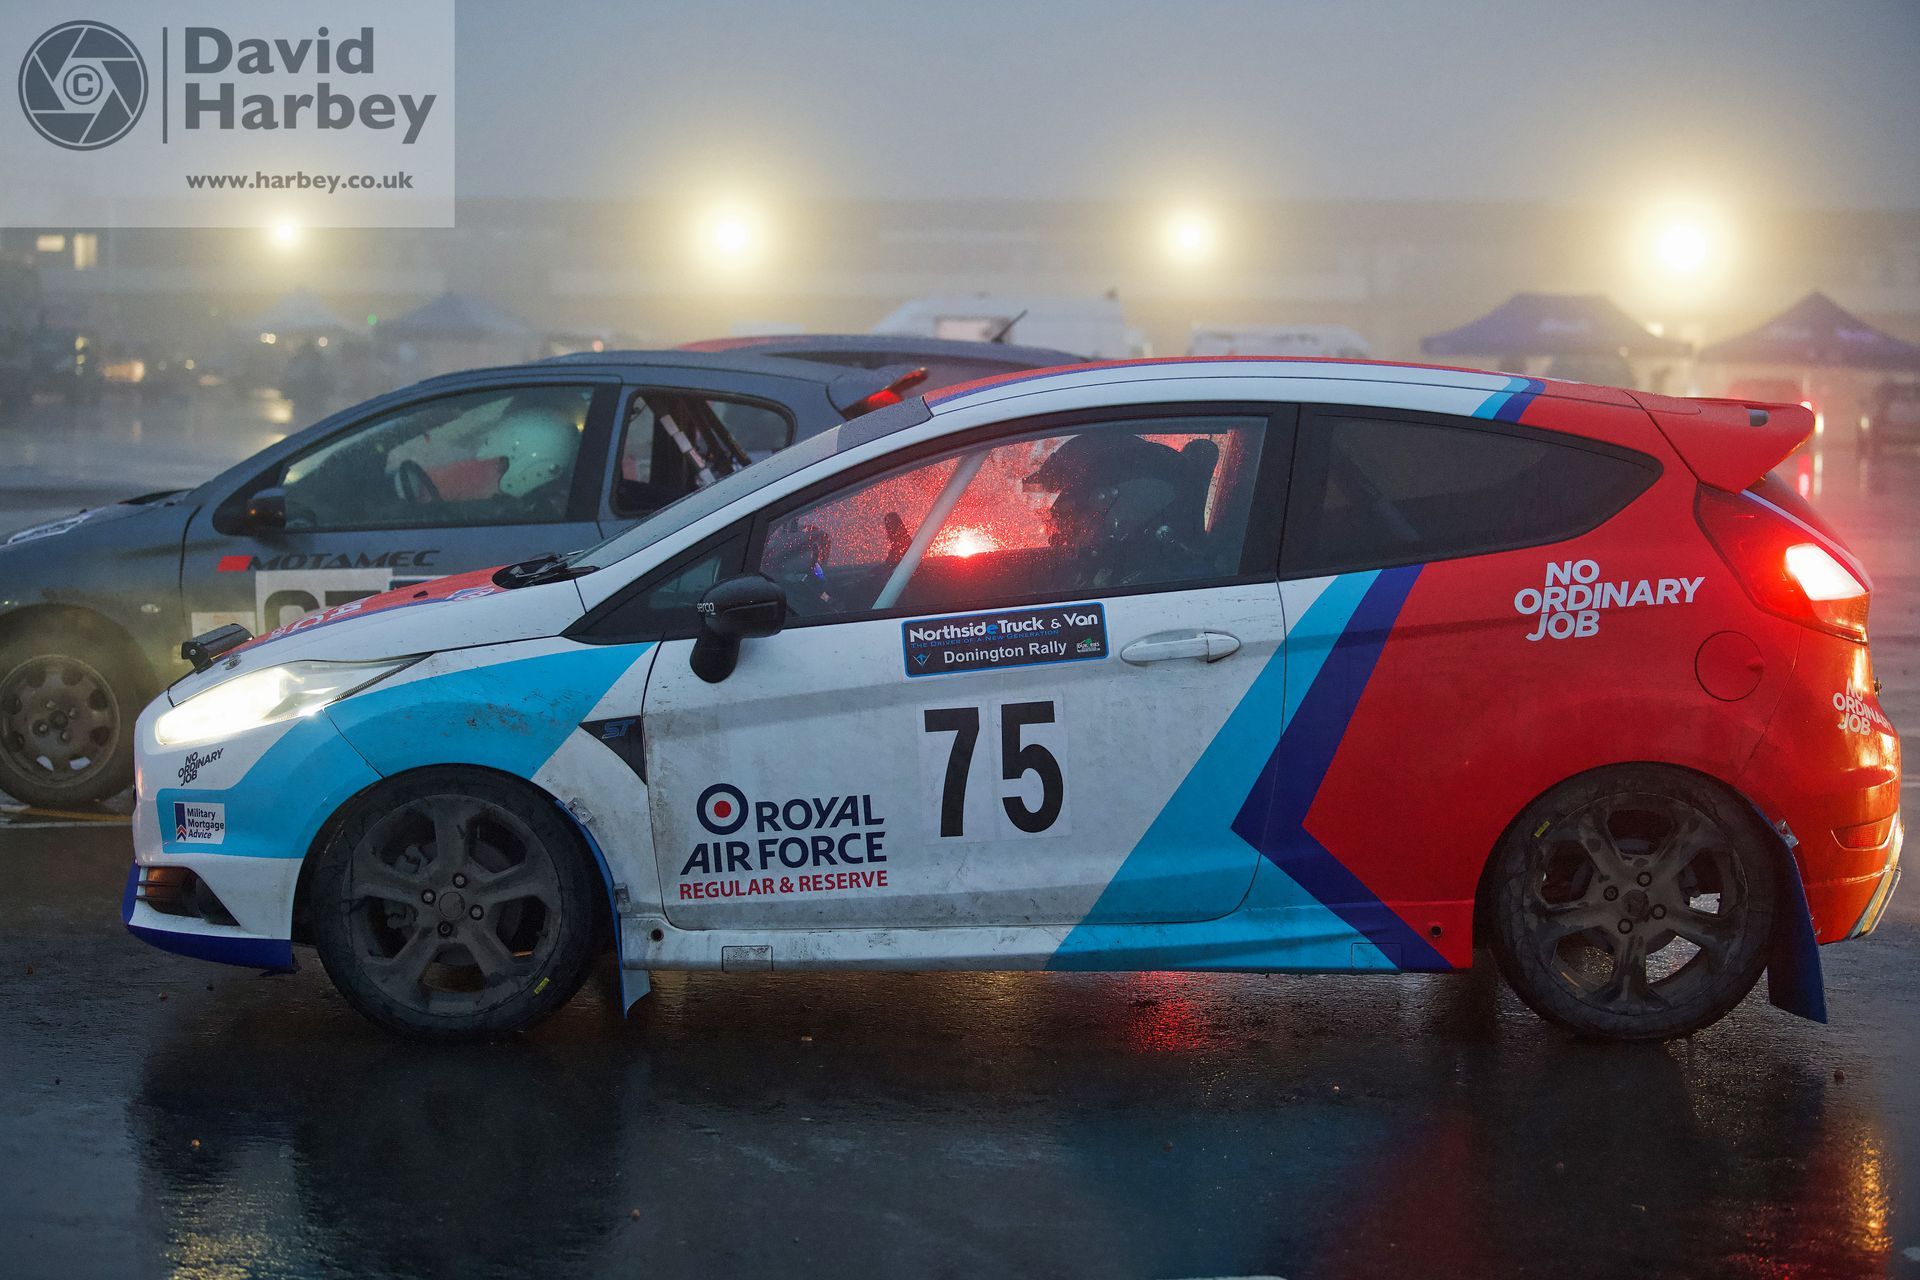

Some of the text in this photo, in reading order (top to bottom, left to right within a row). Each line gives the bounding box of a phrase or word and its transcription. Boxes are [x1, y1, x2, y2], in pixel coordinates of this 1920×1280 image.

[247, 550, 441, 570] MOTAMEC
[1545, 559, 1600, 587] NO
[1513, 576, 1705, 615] ORDINARY
[1050, 618, 1061, 629] &
[1063, 612, 1098, 627] Van
[1525, 609, 1600, 642] JOB
[944, 644, 1024, 664] Donington
[1029, 640, 1067, 656] Rally
[1846, 678, 1864, 702] NO
[1837, 711, 1871, 736] JOB
[178, 748, 224, 778] ORDINARY
[185, 751, 198, 765] NO
[924, 700, 1063, 838] 75
[180, 770, 198, 787] JOB
[187, 808, 216, 820] Military
[187, 818, 225, 832] Mortgage
[755, 794, 885, 833] ROYAL
[188, 829, 212, 839] Advice
[680, 831, 887, 876] AIR FORCE
[679, 870, 889, 900] REGULAR & RESERVE
